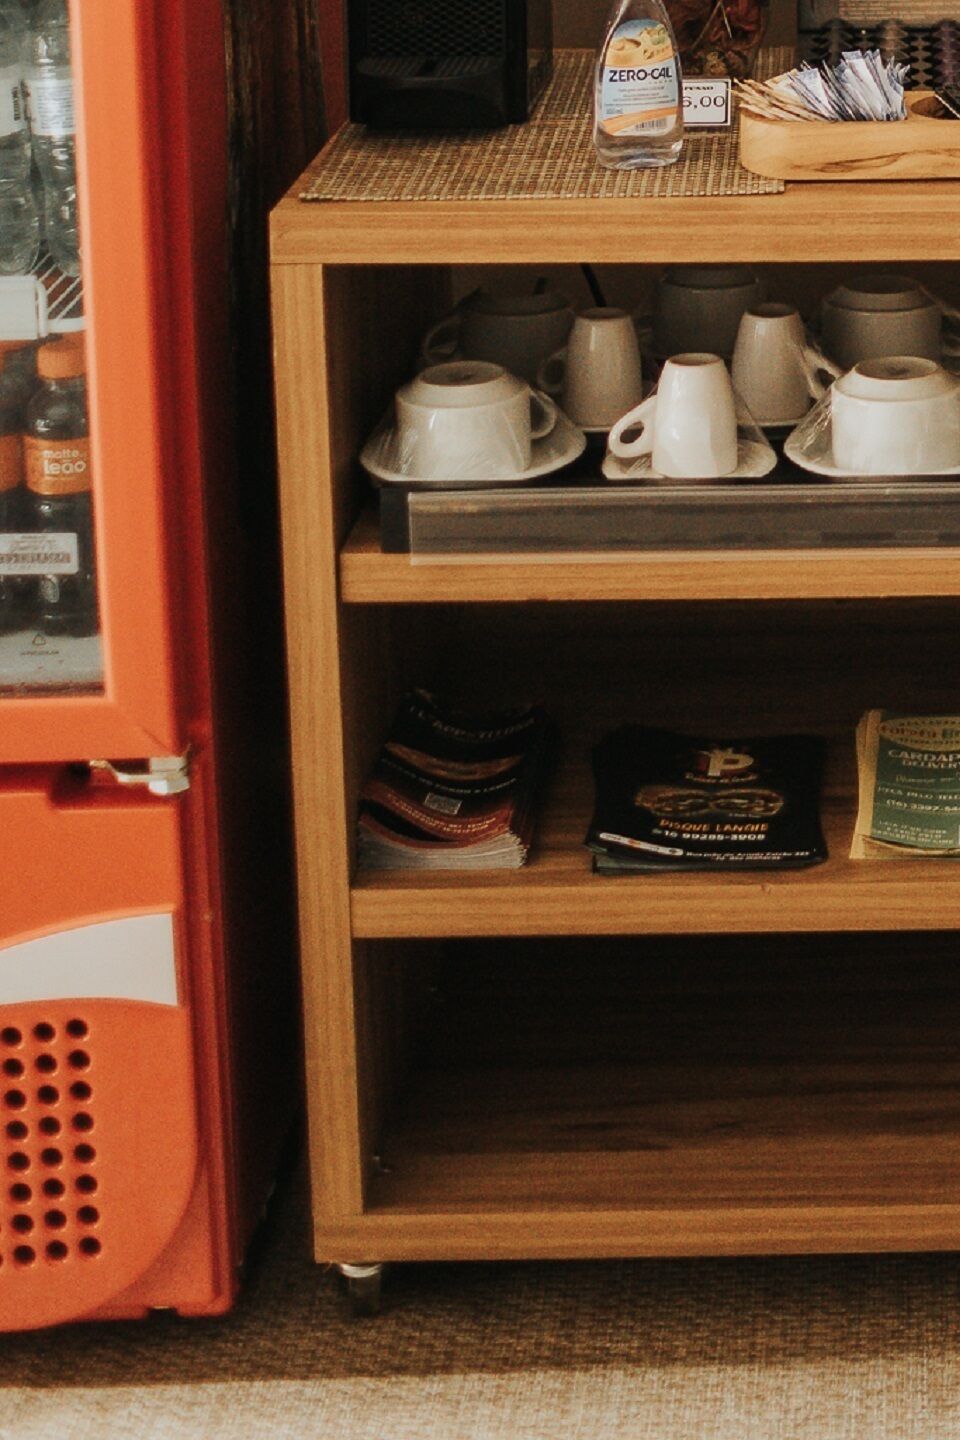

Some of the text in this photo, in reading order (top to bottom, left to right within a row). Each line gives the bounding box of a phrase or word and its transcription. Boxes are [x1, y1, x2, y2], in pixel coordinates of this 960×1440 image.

[608, 67, 673, 82] ZERO-CAL
[44, 459, 87, 475] leão
[659, 818, 710, 832] DISQUE
